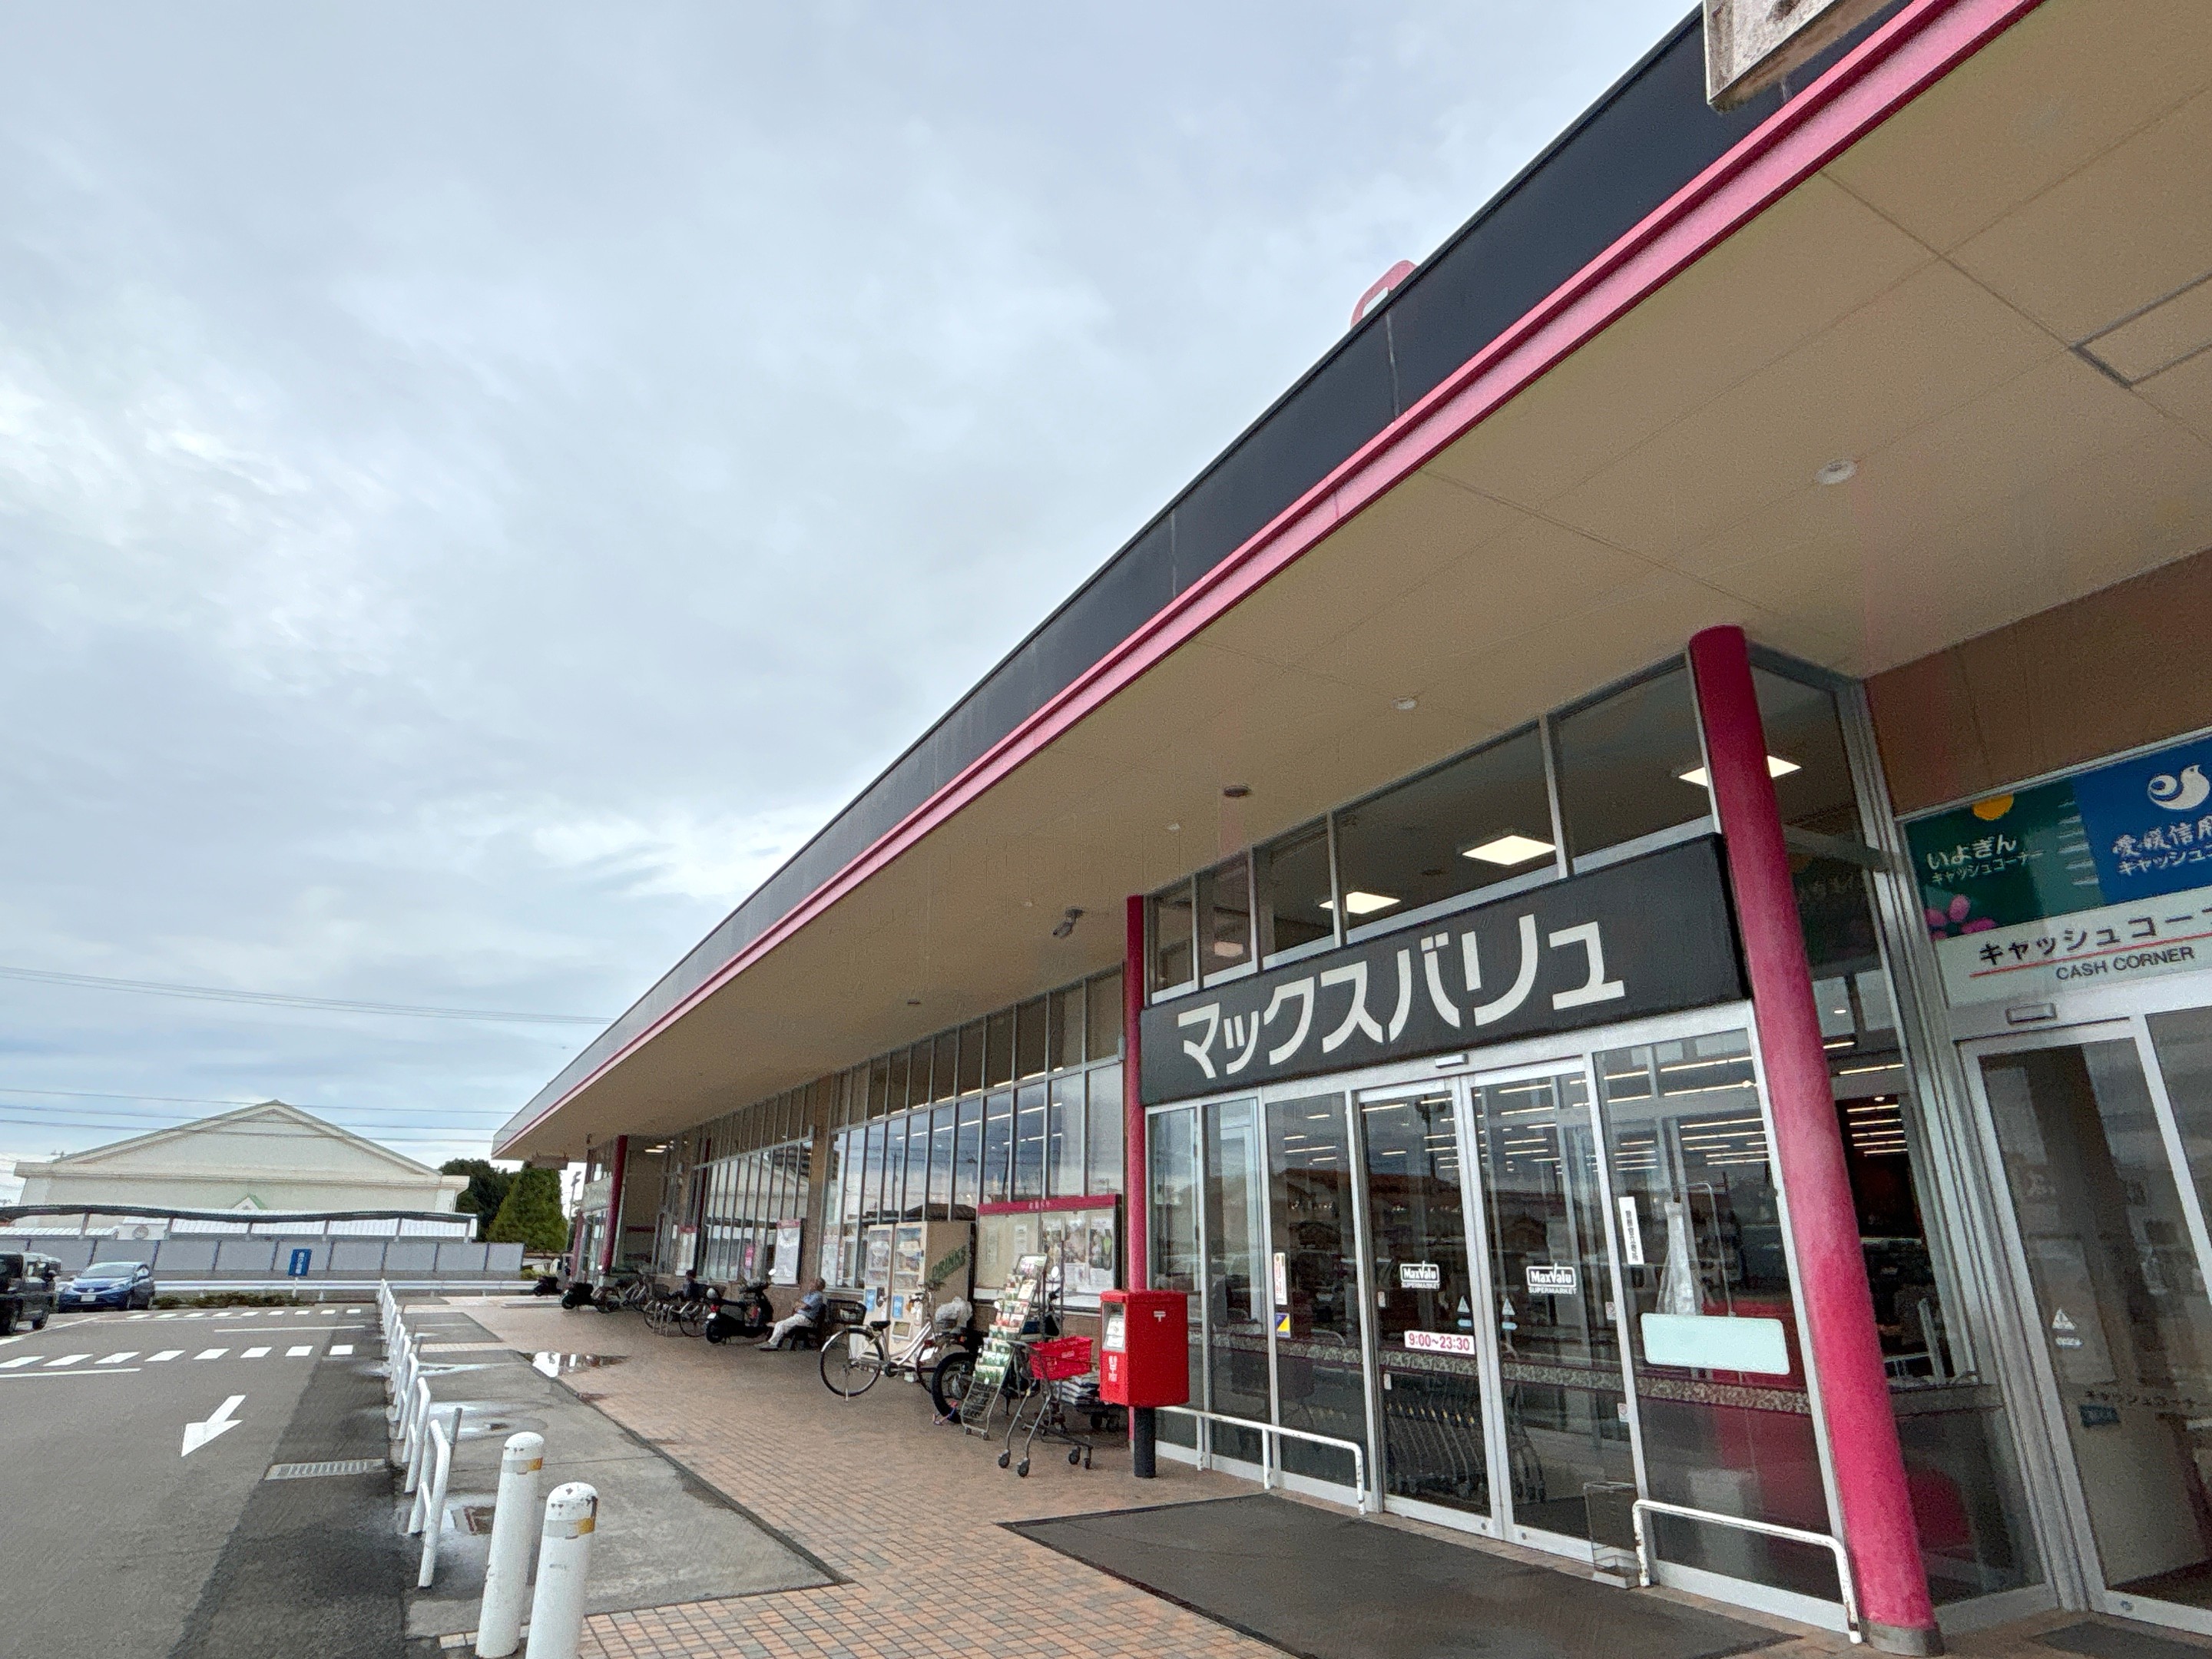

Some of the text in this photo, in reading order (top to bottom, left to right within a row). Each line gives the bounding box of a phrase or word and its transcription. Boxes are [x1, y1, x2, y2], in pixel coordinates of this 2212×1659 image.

[1926, 833, 2017, 870] いよぎん
[1932, 849, 2045, 885] キャッシュコーナー
[2056, 945, 2195, 981] CASH CORNER
[1177, 913, 1625, 1079] マックスバリュ
[1402, 1260, 1438, 1280] MaxValu
[1530, 1263, 1572, 1285] MaxValu
[1528, 1286, 1578, 1295] SUPERMARKET
